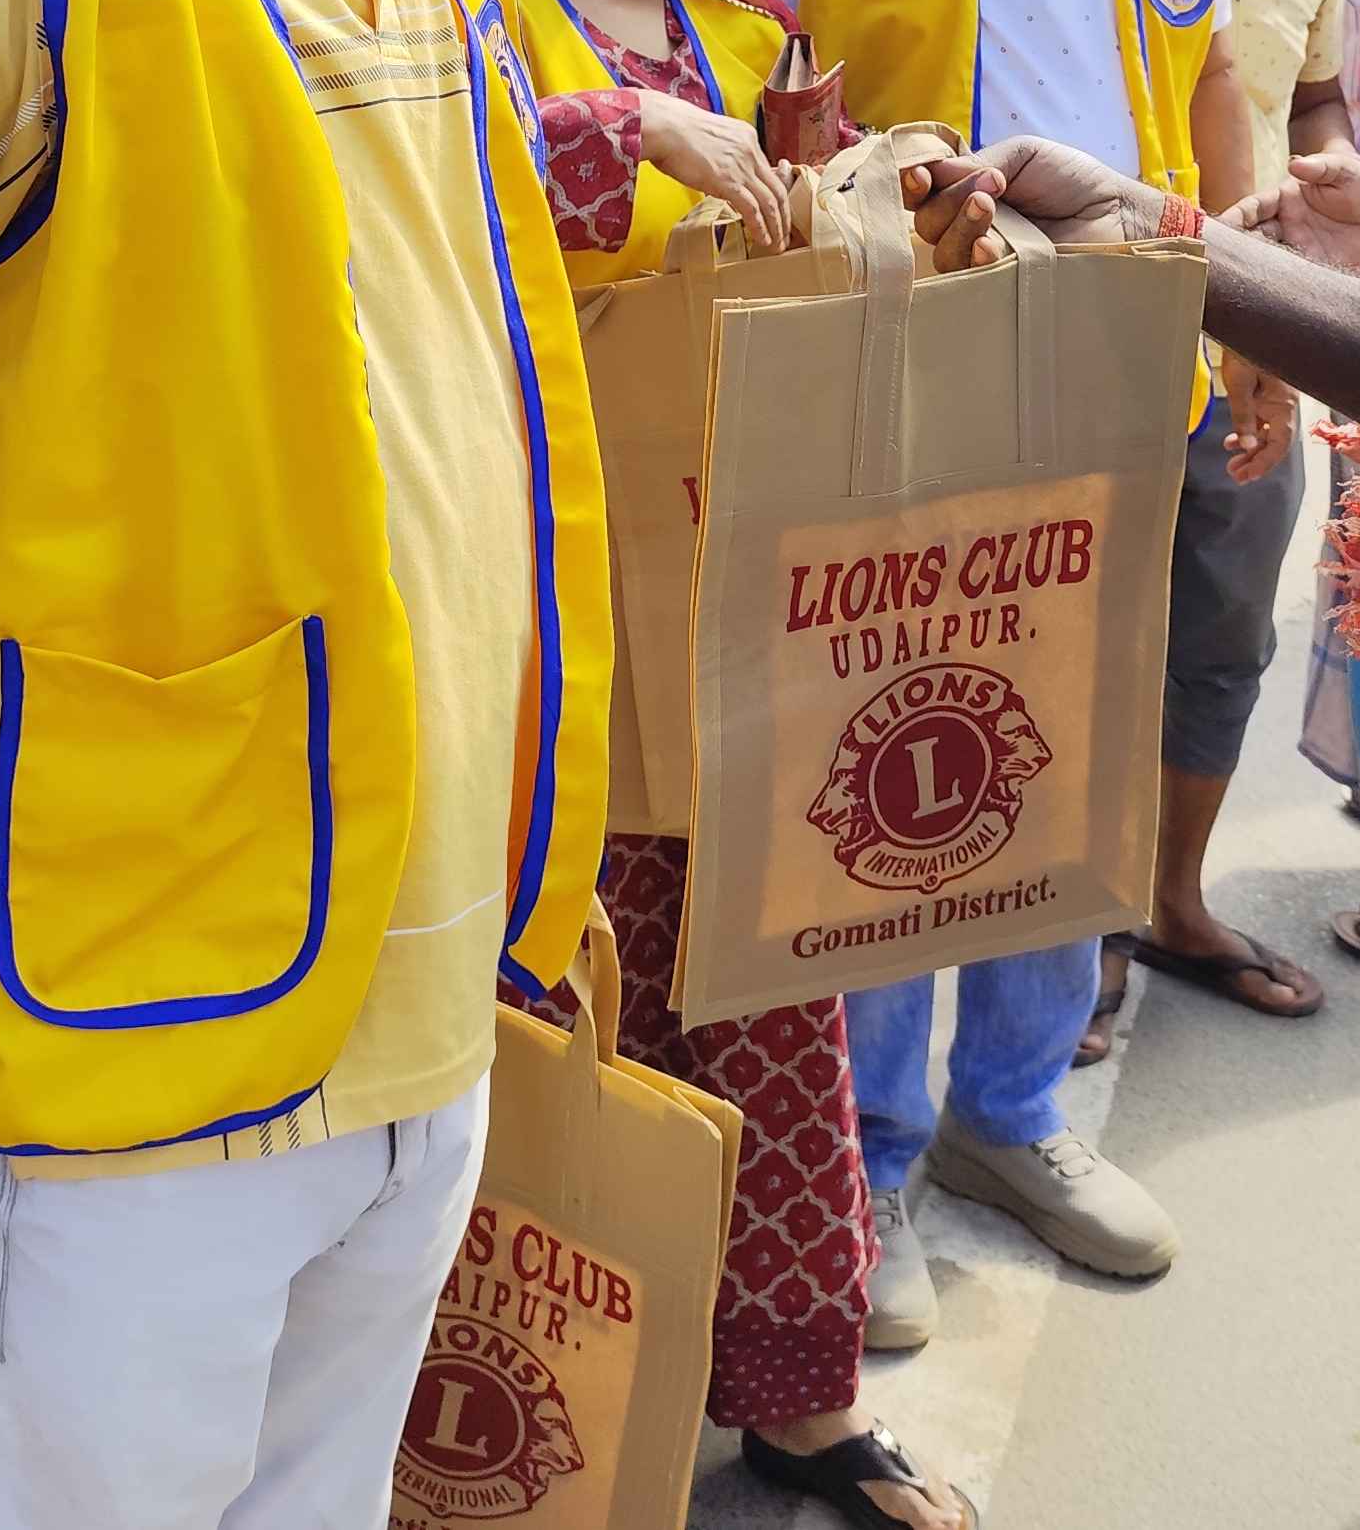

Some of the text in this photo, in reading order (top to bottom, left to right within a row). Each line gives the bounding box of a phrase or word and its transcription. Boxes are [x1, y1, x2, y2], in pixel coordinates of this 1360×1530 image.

[785, 518, 1095, 633] LIONS CLUB
[829, 603, 1038, 679] UDAIPUR.
[858, 671, 1000, 736] LIONS
[904, 736, 964, 820] L
[863, 821, 1000, 878] INTERNATIONAL
[790, 872, 1058, 959] Gomati District.
[441, 1266, 583, 1351] AIPUR.
[511, 1223, 634, 1324] CLUB
[430, 1323, 543, 1386] IONS
[427, 1377, 488, 1458] L
[394, 1461, 518, 1509] TERNATIONAL
